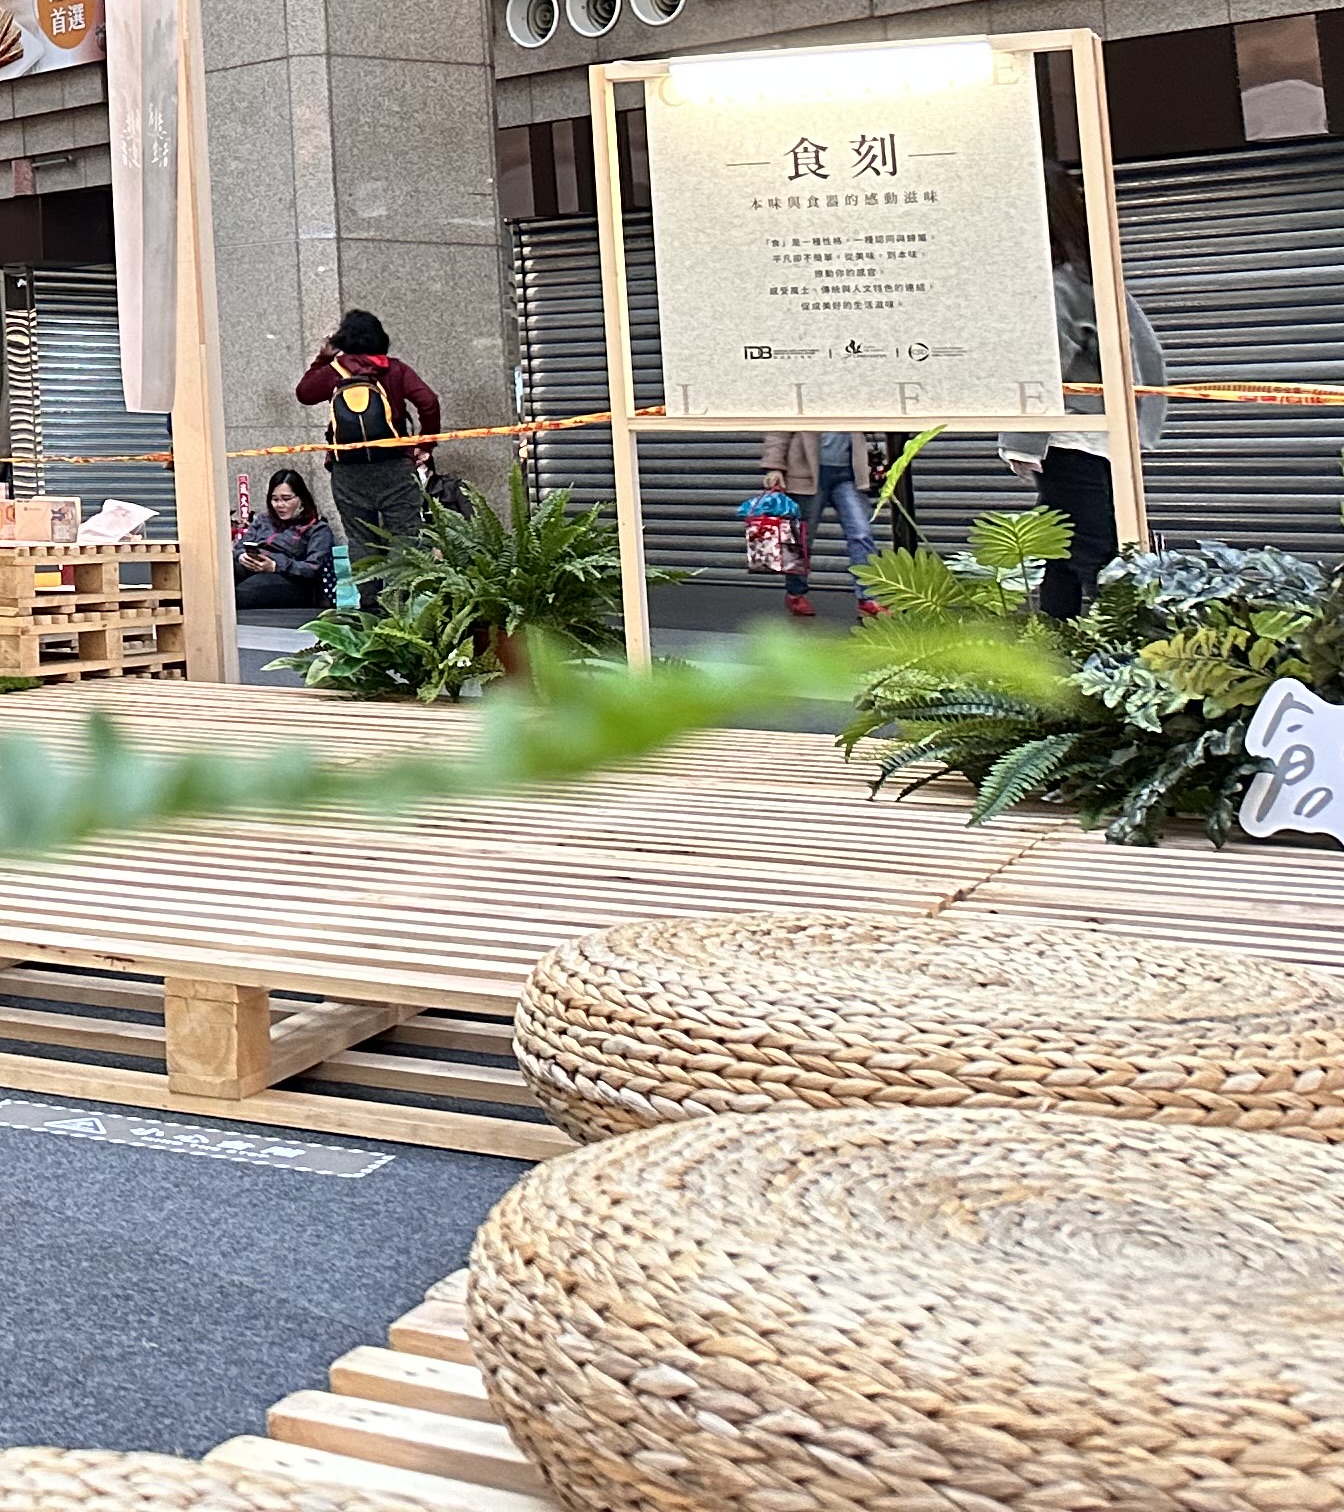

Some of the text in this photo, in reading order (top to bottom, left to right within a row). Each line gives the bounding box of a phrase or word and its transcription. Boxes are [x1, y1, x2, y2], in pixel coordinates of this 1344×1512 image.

[49, 2, 86, 36] 首選
[783, 133, 899, 182] 食刻
[751, 189, 940, 211] 本味與食器的感動滋味
